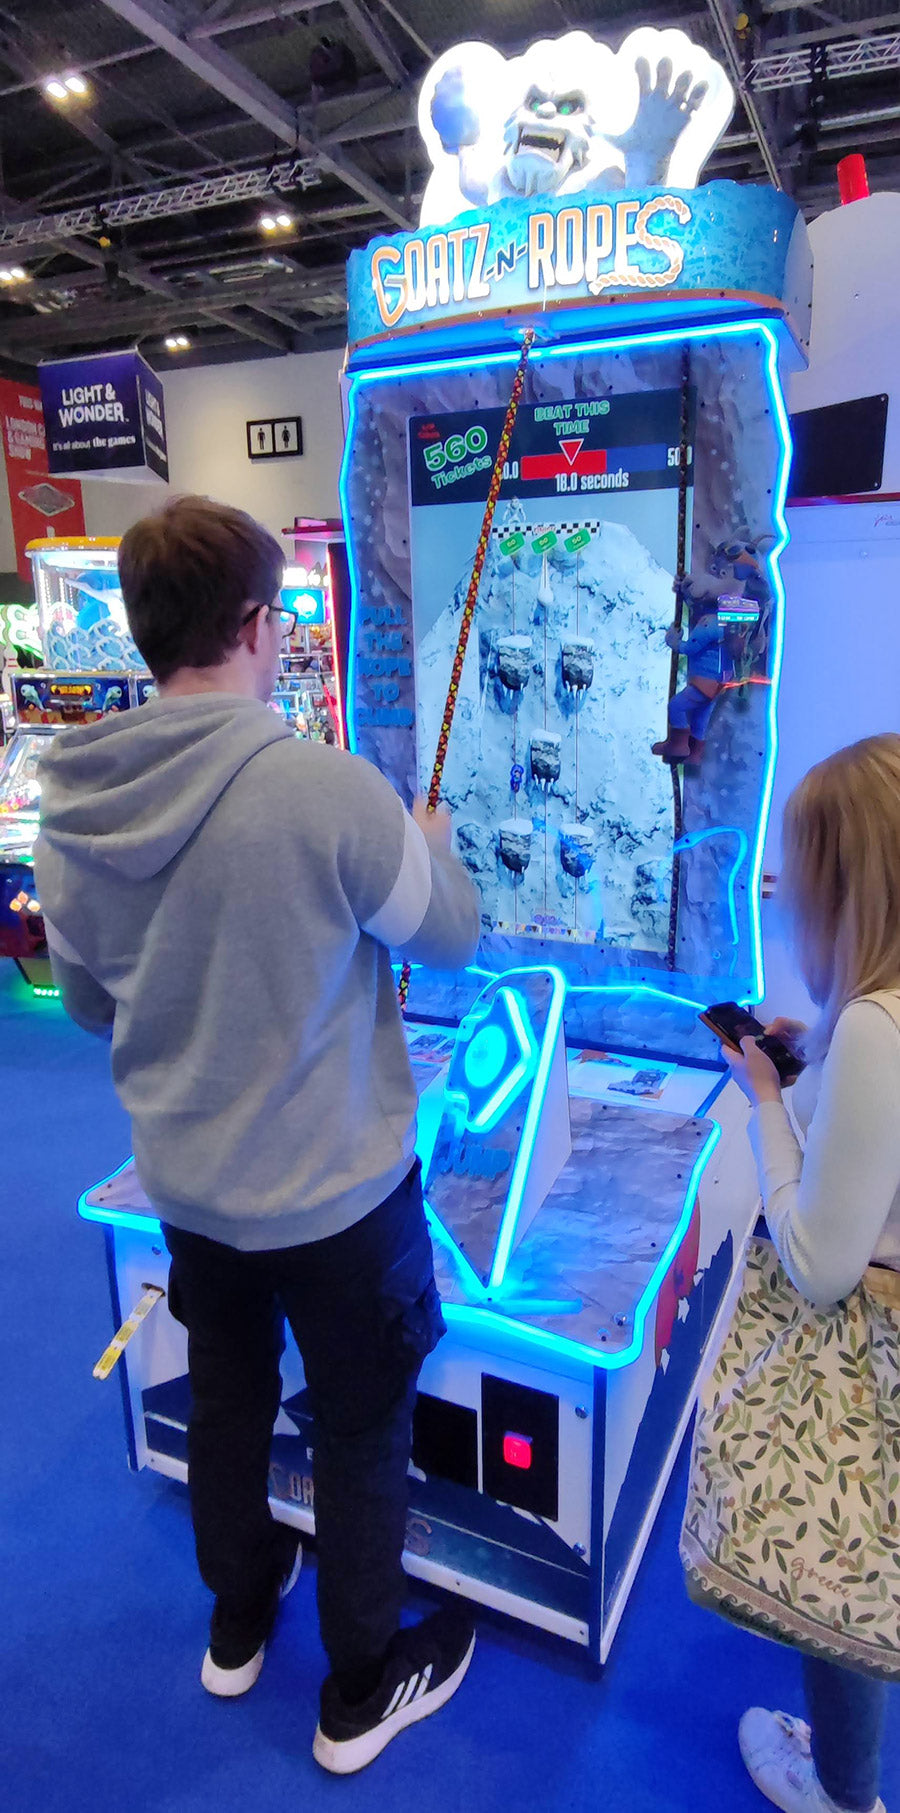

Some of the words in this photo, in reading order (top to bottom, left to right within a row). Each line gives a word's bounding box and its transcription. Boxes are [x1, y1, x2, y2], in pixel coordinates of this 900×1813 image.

[61, 384, 103, 406] LIGHT
[105, 383, 116, 401] &
[58, 402, 125, 428] WONDER
[534, 405, 573, 422] BEAT
[575, 400, 610, 417] THIS
[553, 419, 590, 436] TIME
[93, 436, 107, 447] the
[108, 435, 136, 448] games
[423, 425, 488, 472] 560
[431, 455, 493, 490] Tickets
[555, 472, 578, 492] 18.0
[580, 468, 630, 490] seconds
